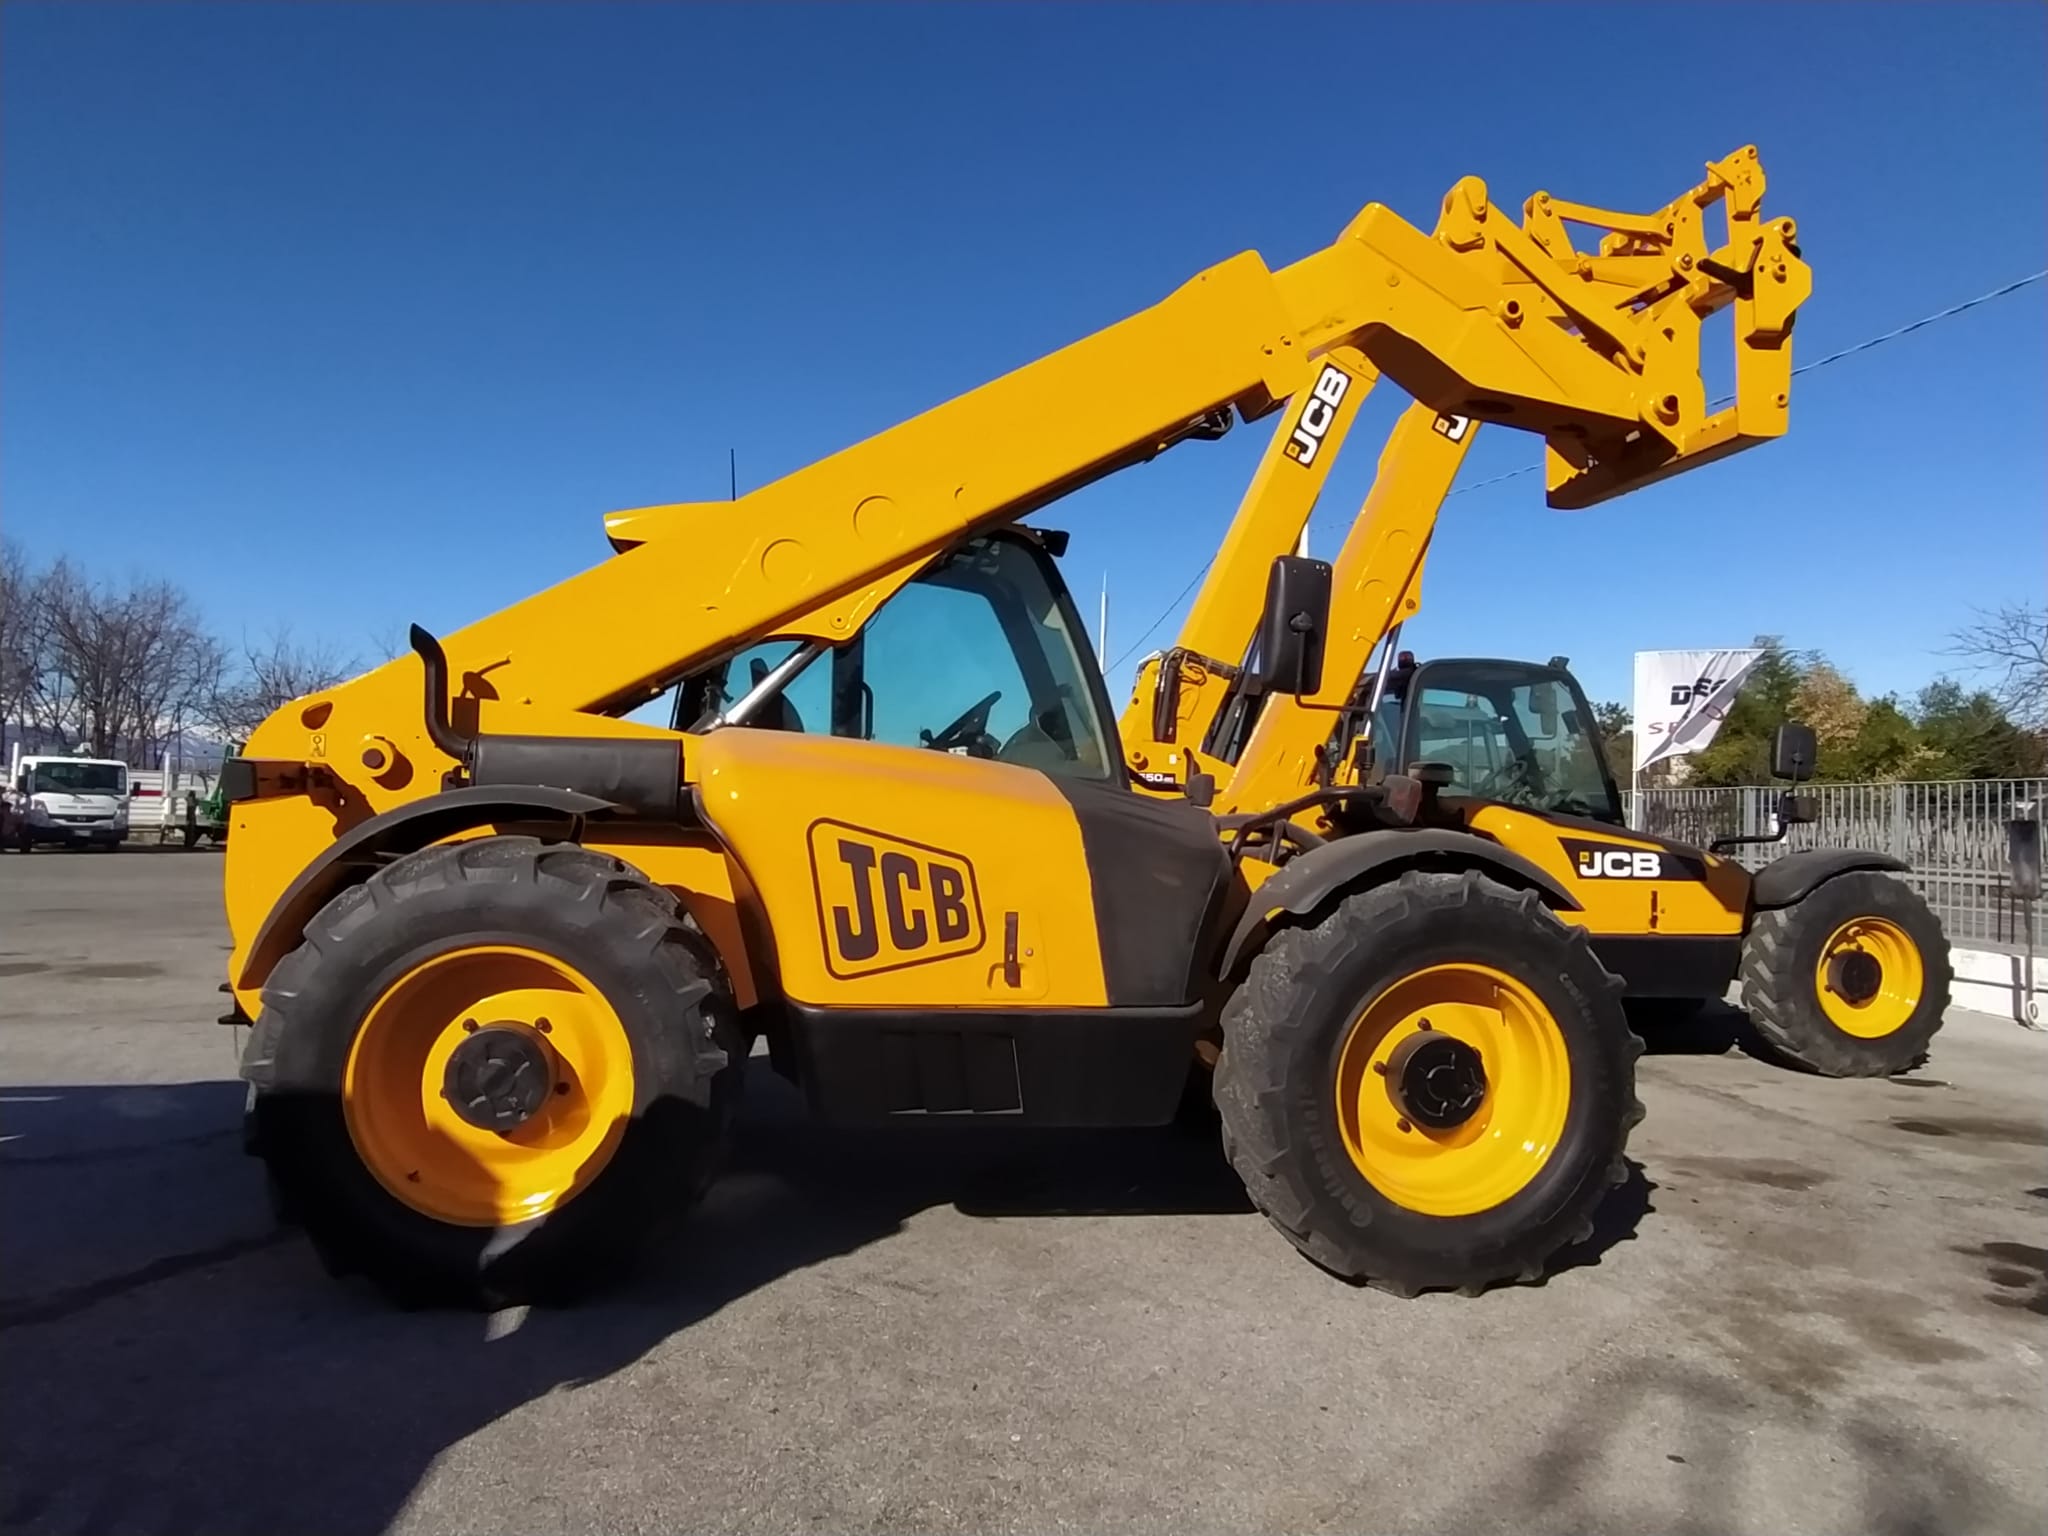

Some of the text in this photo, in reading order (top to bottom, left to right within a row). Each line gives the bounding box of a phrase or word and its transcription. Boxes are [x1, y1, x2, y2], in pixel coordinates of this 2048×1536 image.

[1293, 367, 1349, 465] JCB
[833, 838, 970, 962] JCB
[1579, 851, 1661, 878] JCB
